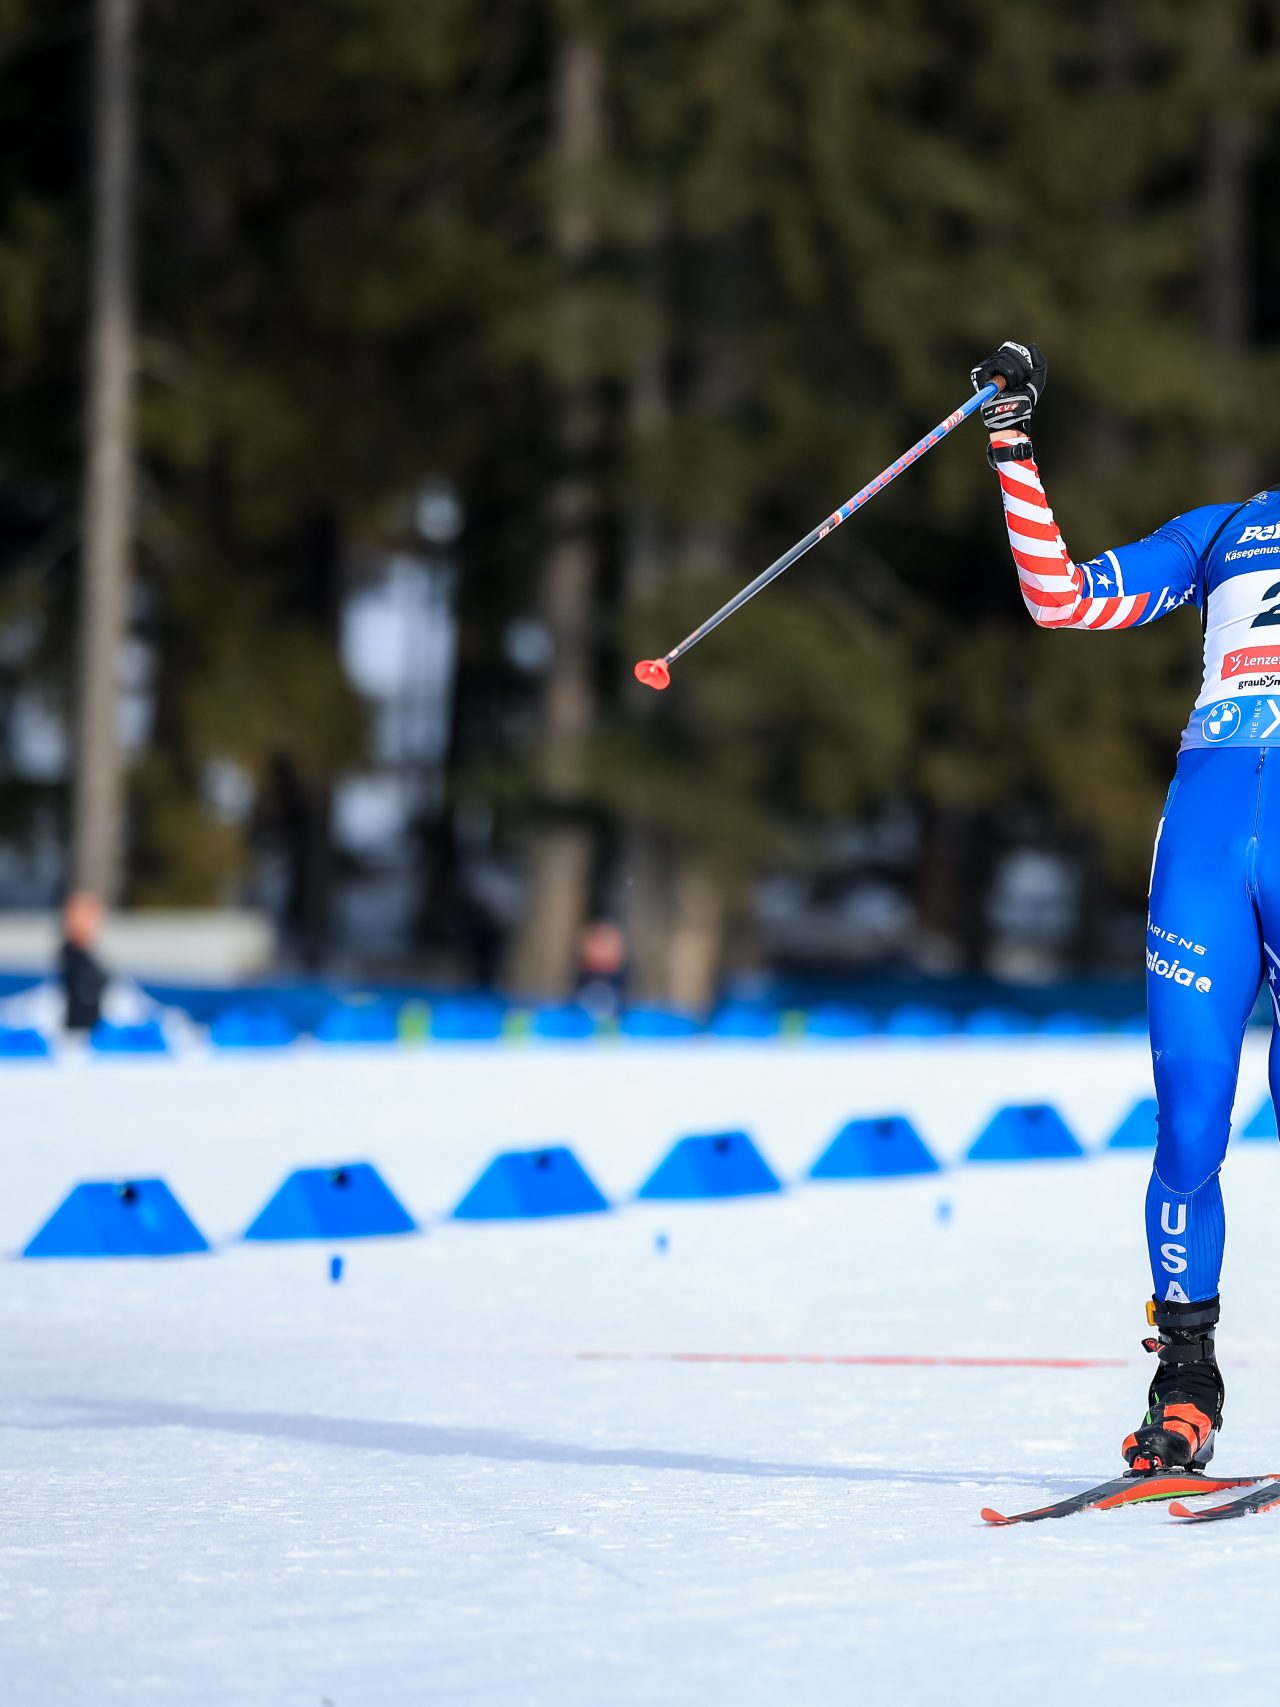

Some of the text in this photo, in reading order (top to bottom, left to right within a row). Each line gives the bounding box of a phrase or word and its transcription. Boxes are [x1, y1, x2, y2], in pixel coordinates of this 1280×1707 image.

[1250, 699, 1263, 739] THE NEW
[1150, 923, 1206, 956] ARIENS
[1146, 946, 1196, 987] aloja
[1160, 1201, 1190, 1304] USA
